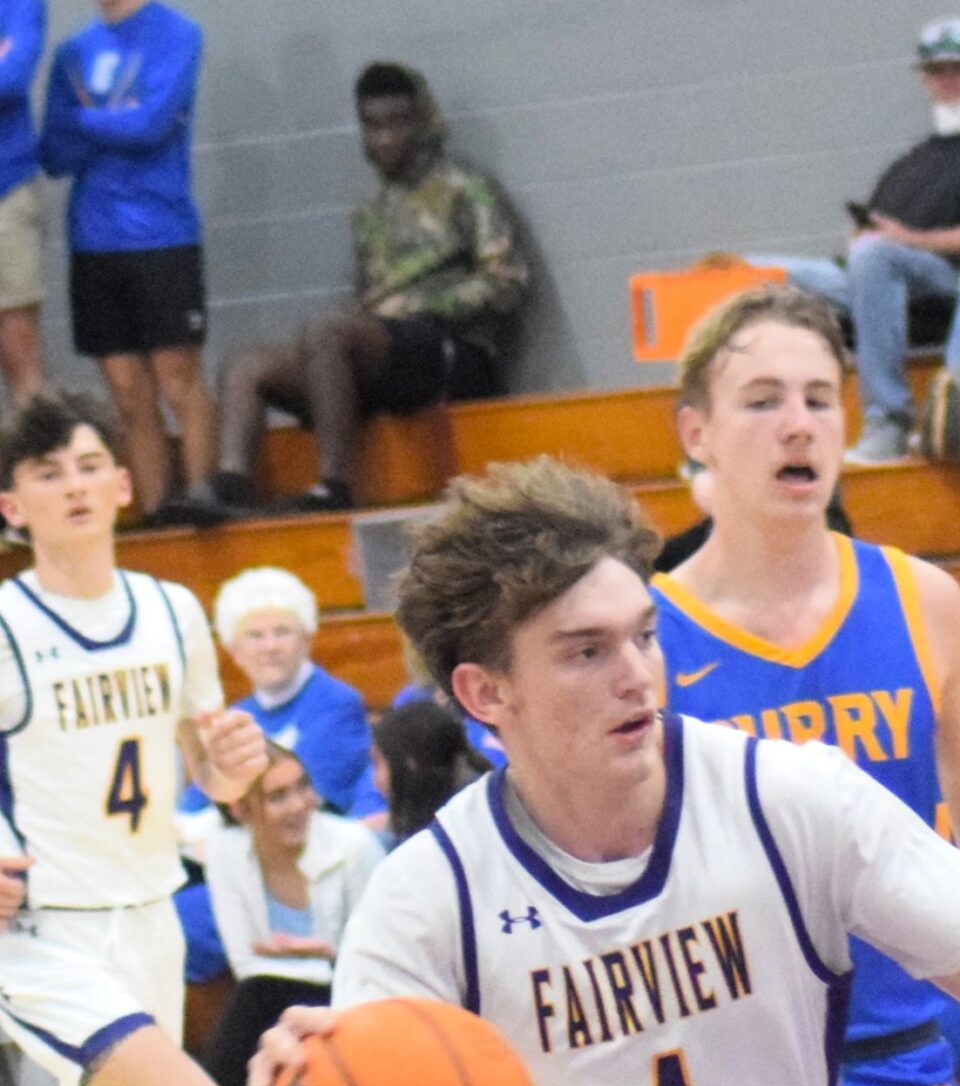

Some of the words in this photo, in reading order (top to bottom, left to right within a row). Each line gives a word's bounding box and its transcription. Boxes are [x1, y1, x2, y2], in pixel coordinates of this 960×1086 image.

[52, 661, 171, 732] FAIRVIEW
[104, 734, 150, 836] 4
[529, 909, 753, 1054] FAIRVIEW
